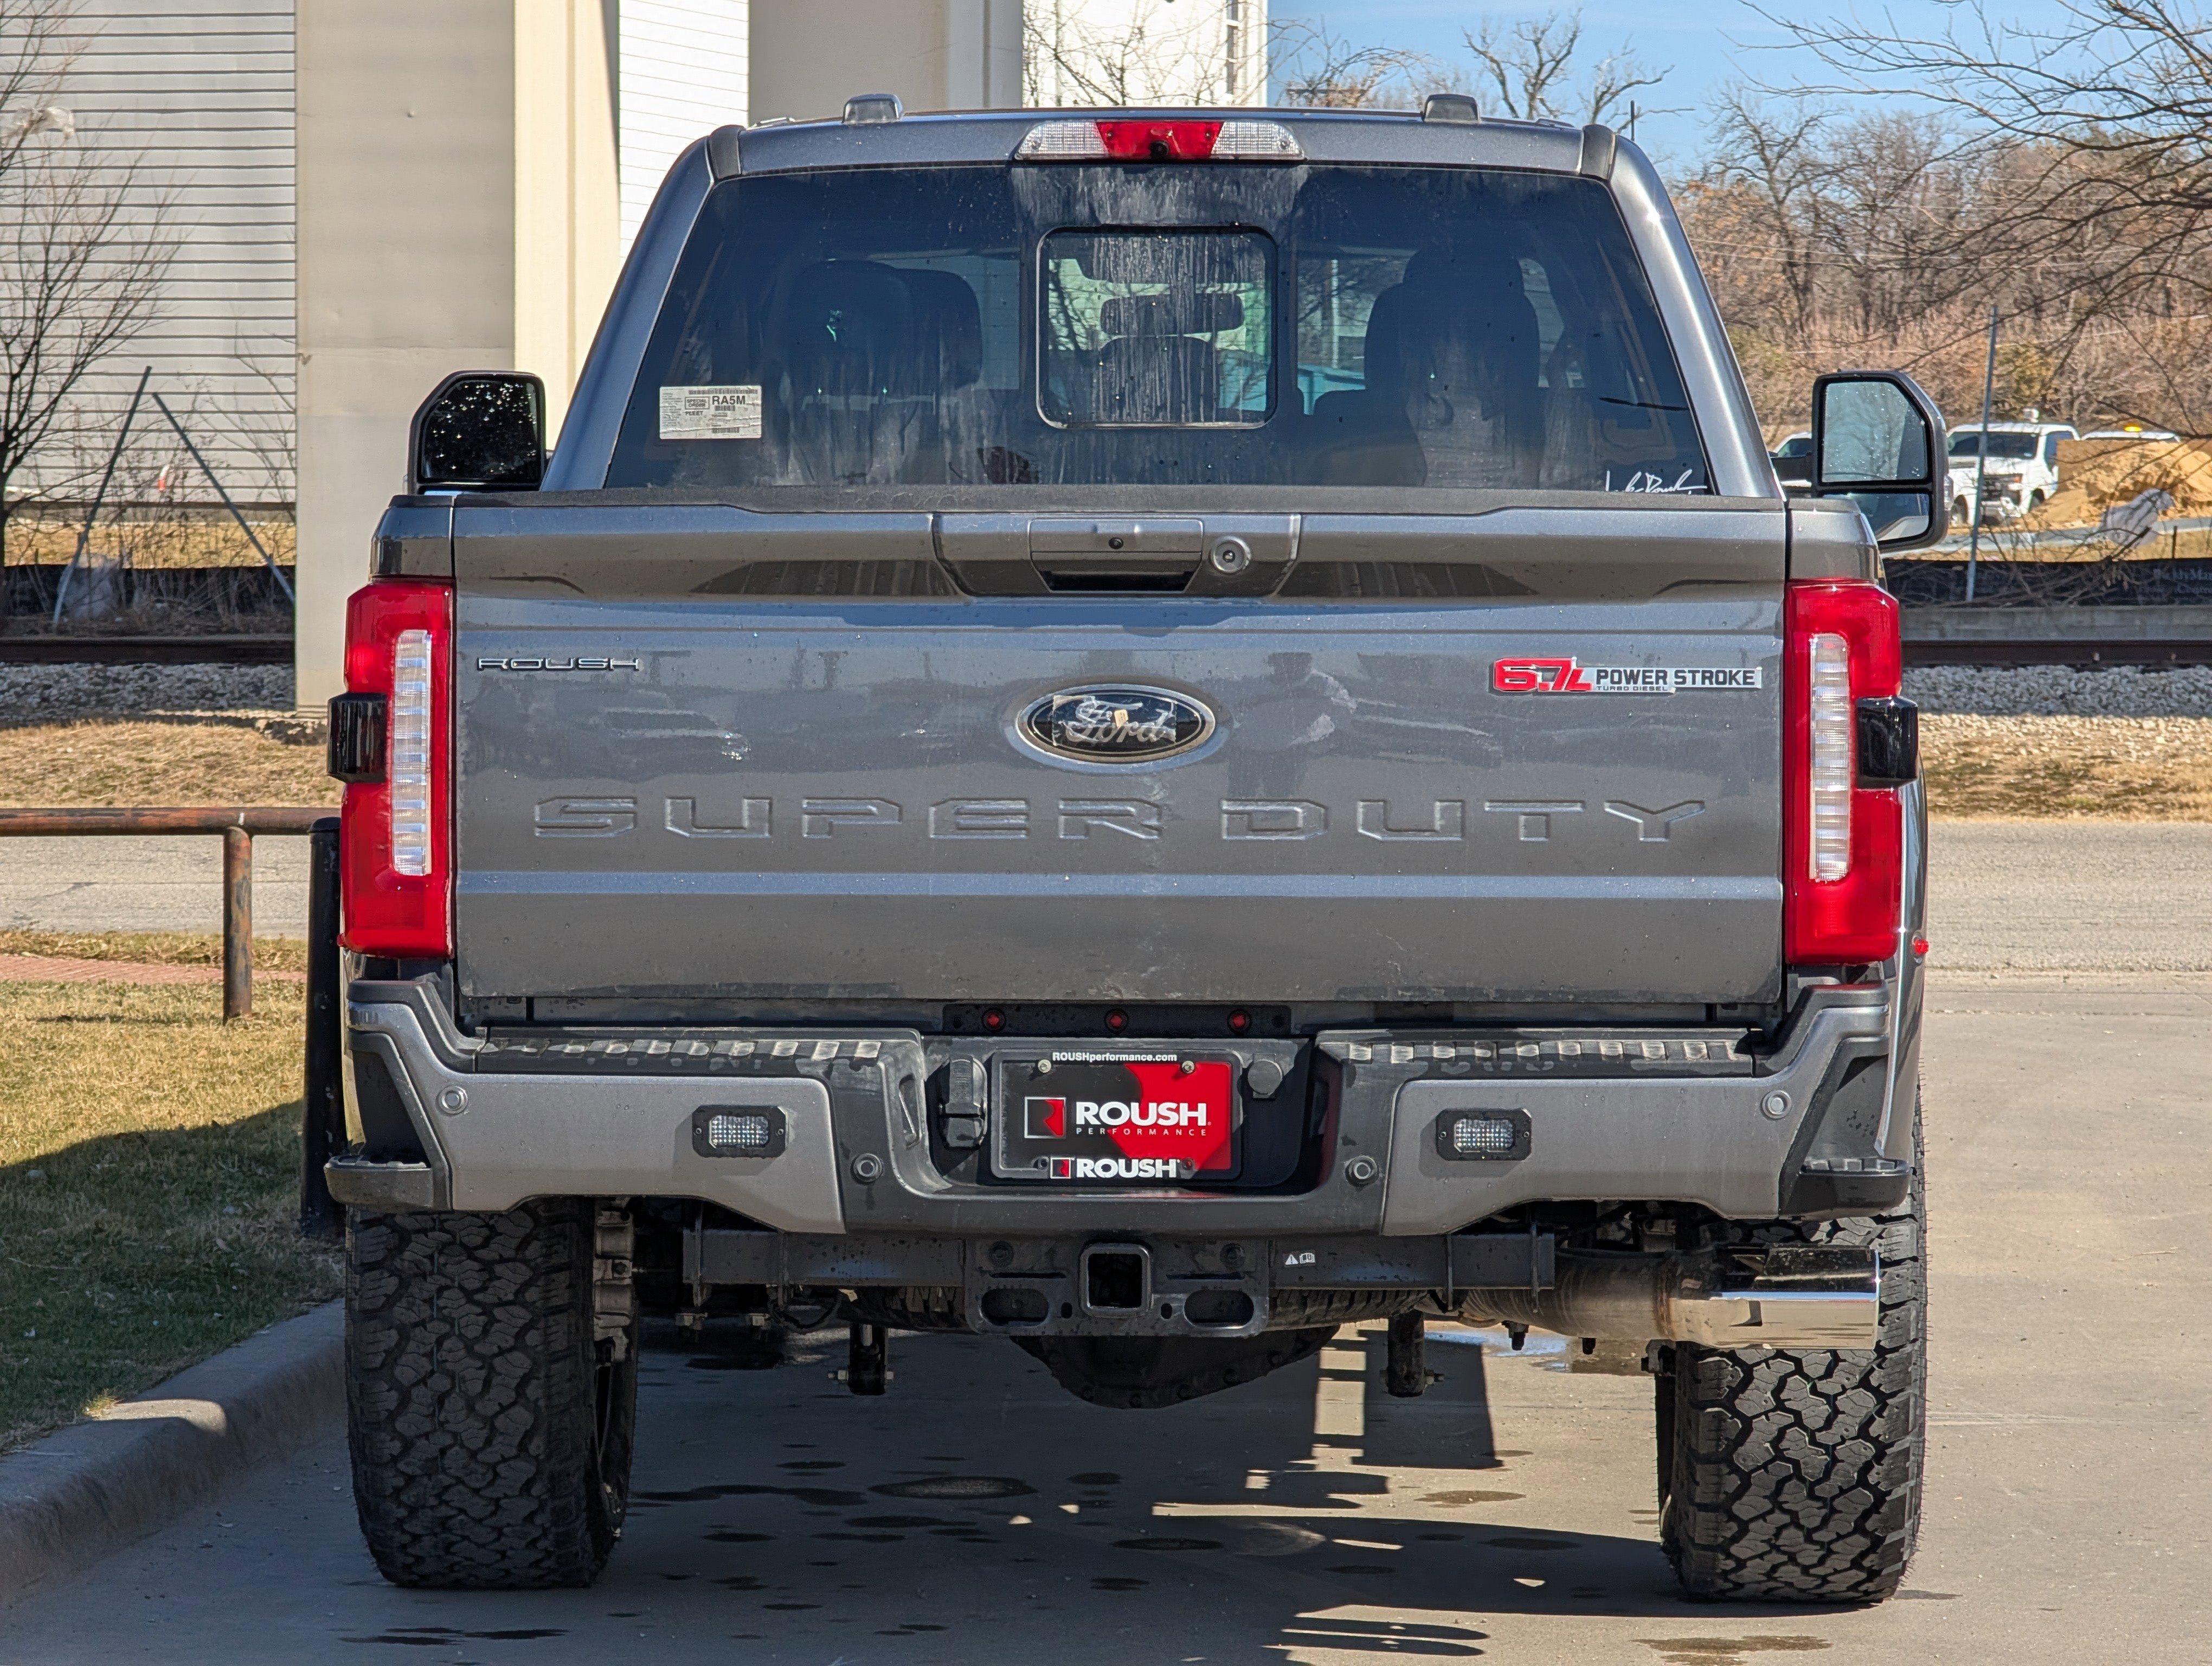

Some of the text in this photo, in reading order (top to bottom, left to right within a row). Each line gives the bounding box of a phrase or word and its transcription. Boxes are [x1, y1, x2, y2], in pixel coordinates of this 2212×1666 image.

[712, 395, 745, 405] RA5M
[477, 657, 641, 671] ROUSH
[1596, 669, 1668, 685] POWER
[1674, 669, 1756, 686] STROKE
[1063, 699, 1171, 743] Ford
[533, 796, 1707, 842] SUPER DUTY
[1052, 1052, 1178, 1063] ROUSHperformance.com
[1076, 1127, 1207, 1137] PERFORMANCE
